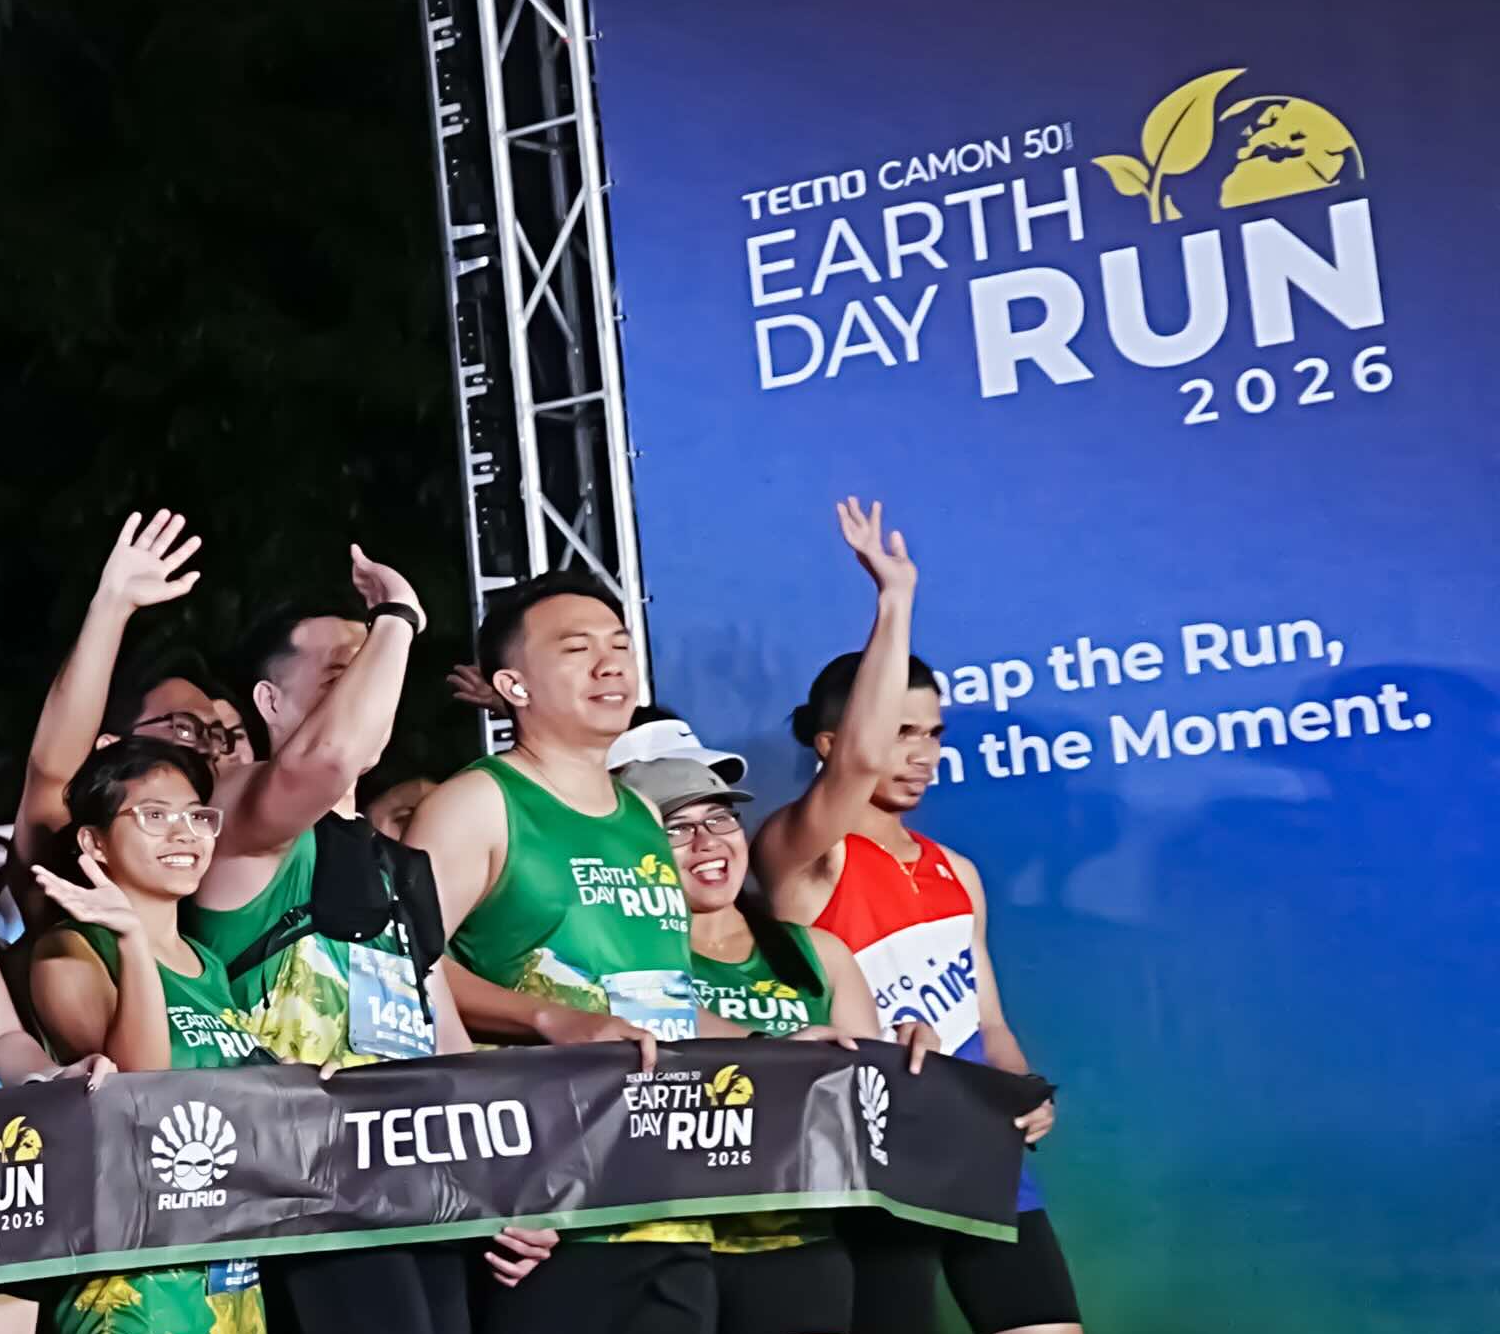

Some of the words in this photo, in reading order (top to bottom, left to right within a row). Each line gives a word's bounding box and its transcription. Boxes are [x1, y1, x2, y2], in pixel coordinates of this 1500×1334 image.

[742, 169, 866, 220] TECNO
[877, 136, 1011, 190] CAMON
[1022, 124, 1064, 159] 50
[746, 167, 1085, 308] EARTH
[755, 283, 939, 390] DAY
[969, 199, 1384, 398] RUN
[1179, 347, 1393, 425] 2026
[1047, 637, 1164, 691] the
[1181, 619, 1344, 676] Run,
[980, 725, 1092, 779] the
[1109, 683, 1432, 765] Moment.
[572, 866, 636, 886] EARTH
[579, 886, 616, 905] DAY
[618, 886, 688, 918] RUN
[172, 1011, 224, 1032] EARTH
[718, 998, 809, 1023] RUN
[623, 1084, 702, 1111] EARTH
[344, 1099, 533, 1169] TECNO
[630, 1112, 664, 1138] DAY
[667, 1108, 754, 1150] RUN
[707, 1150, 752, 1167] 2026
[157, 1189, 227, 1211] RUNRIO
[1, 1210, 44, 1231] 2026
